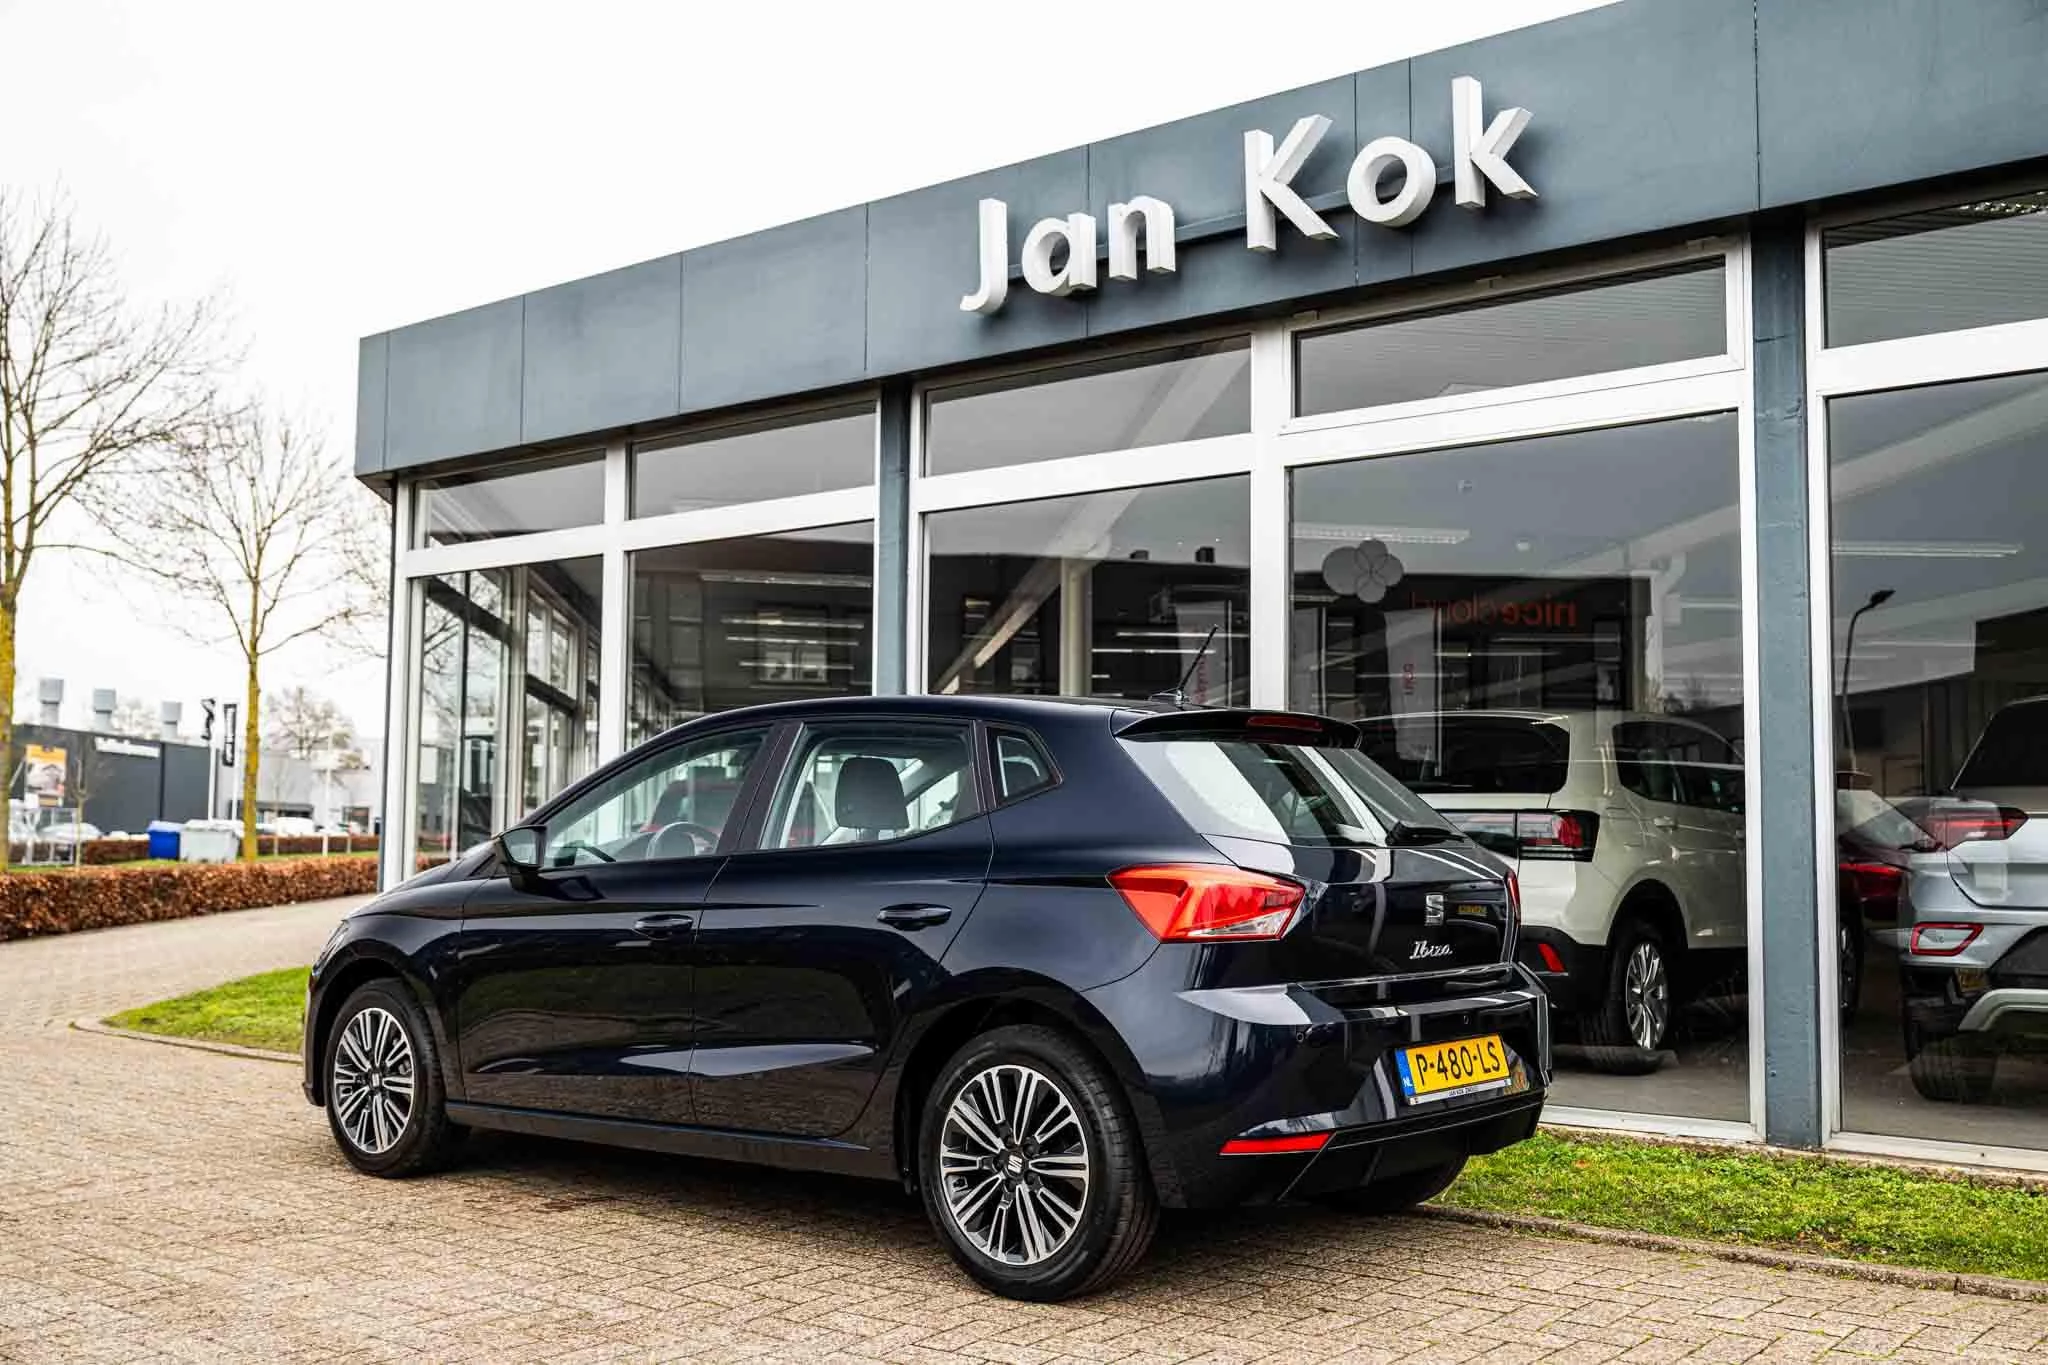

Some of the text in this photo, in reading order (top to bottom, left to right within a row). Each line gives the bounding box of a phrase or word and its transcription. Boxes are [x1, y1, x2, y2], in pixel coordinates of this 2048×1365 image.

[960, 75, 1538, 316] Jan Kok
[1409, 940, 1453, 960] Ibiza
[1415, 1041, 1500, 1086] P-480-LS
[1402, 1077, 1413, 1087] NL
